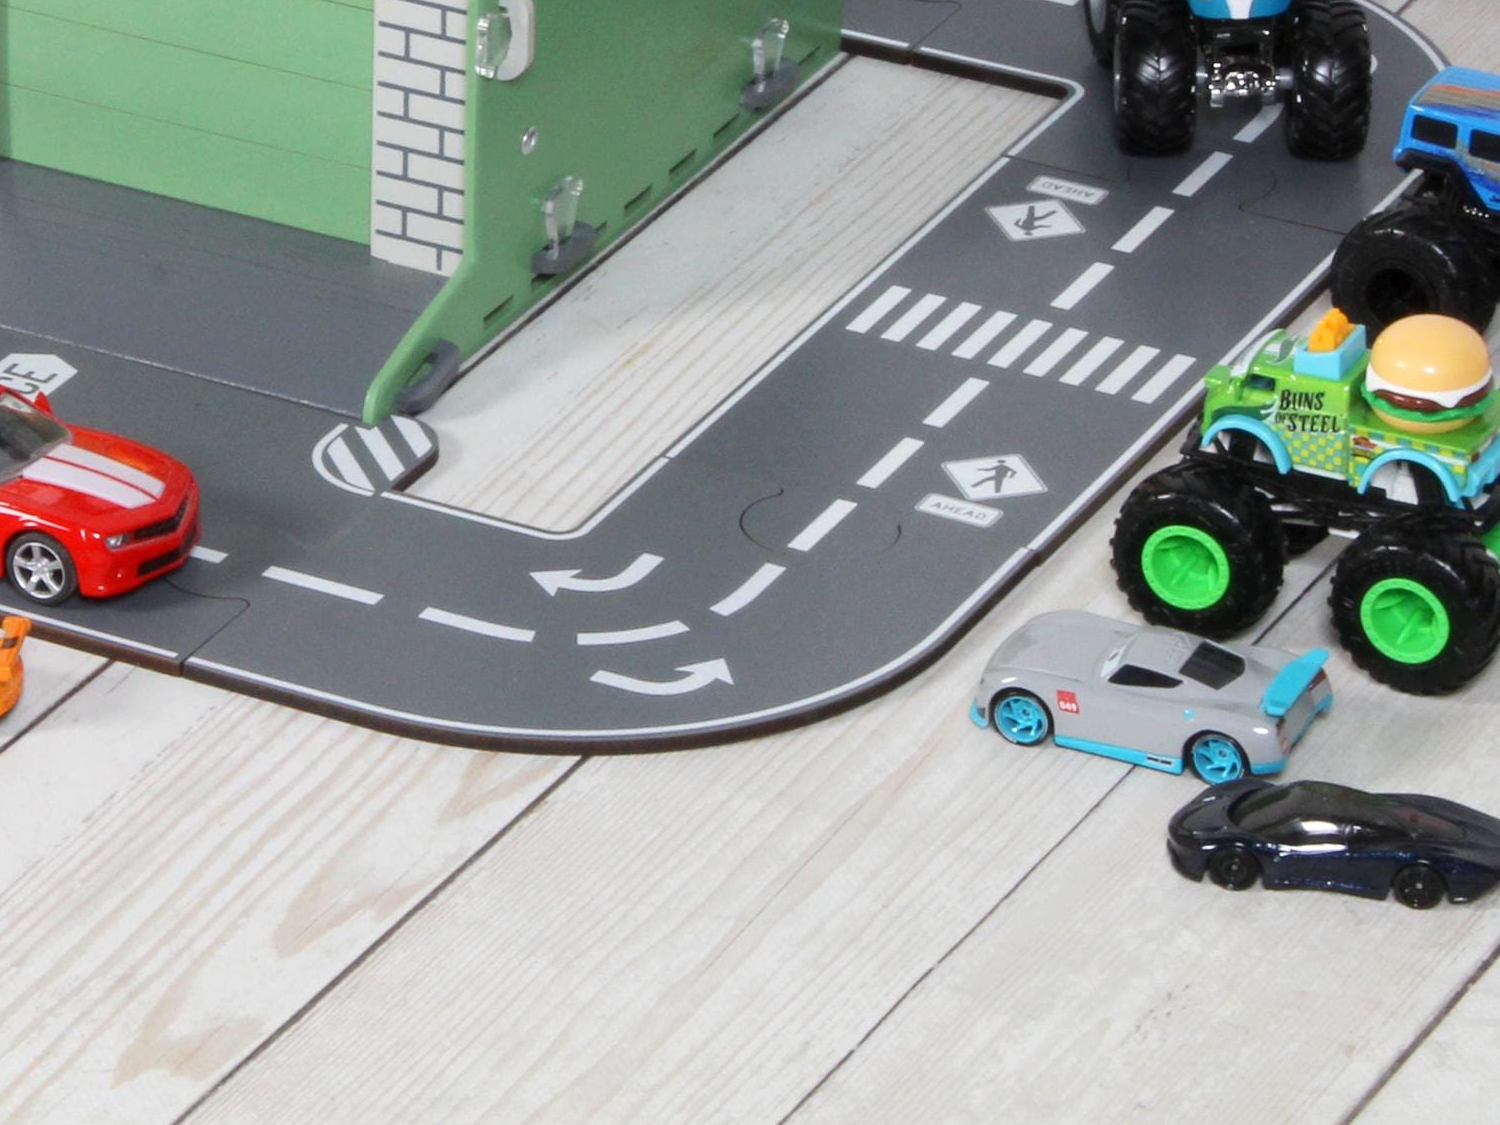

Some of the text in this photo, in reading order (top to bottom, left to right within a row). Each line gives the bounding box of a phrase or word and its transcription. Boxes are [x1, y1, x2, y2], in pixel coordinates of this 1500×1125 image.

[1041, 181, 1096, 198] AHEAD
[1280, 388, 1325, 411] BUNS
[1287, 414, 1341, 433] STEEL
[931, 501, 987, 520] AHEAD
